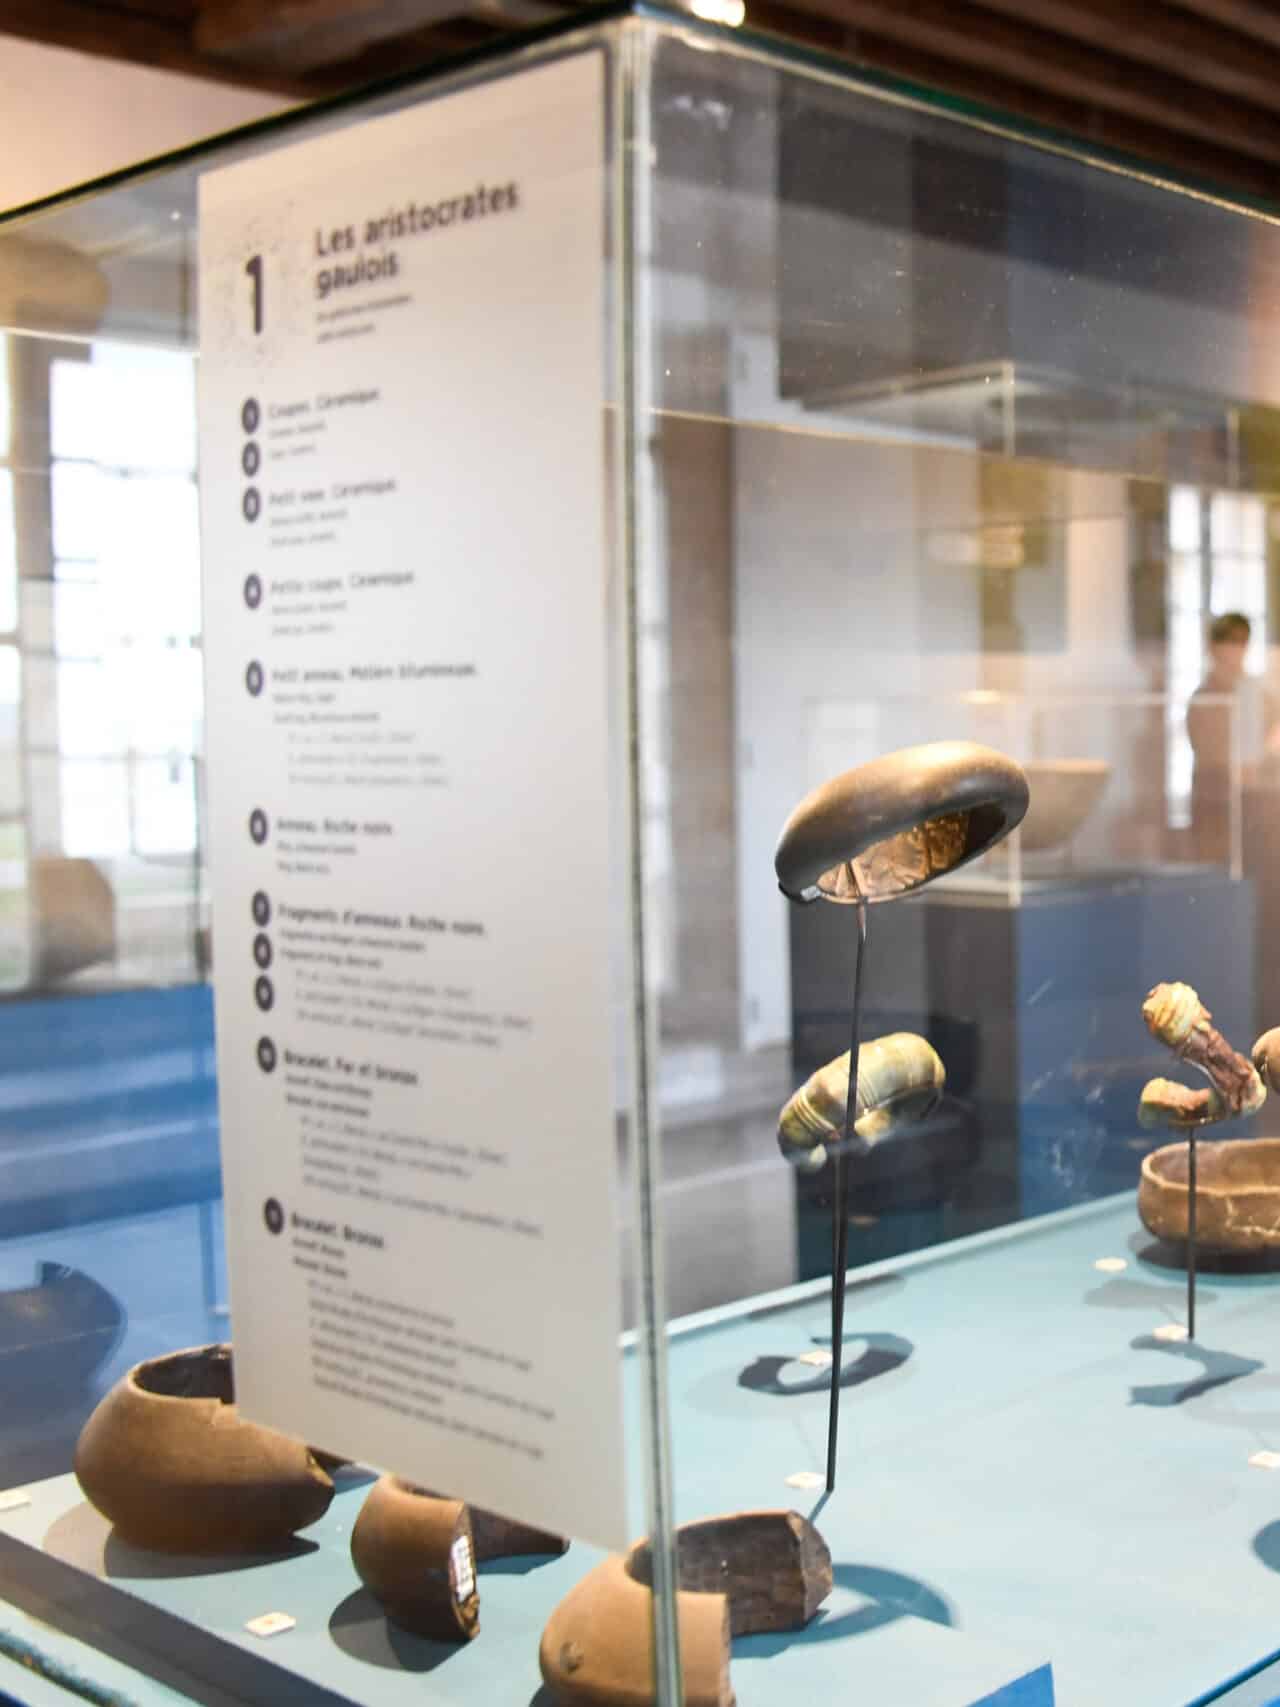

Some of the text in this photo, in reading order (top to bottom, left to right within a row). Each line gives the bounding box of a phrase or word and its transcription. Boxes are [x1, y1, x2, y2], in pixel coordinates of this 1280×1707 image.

[316, 181, 518, 256] Les aristocrates
[246, 255, 262, 334] 1
[316, 251, 398, 299] gaulois
